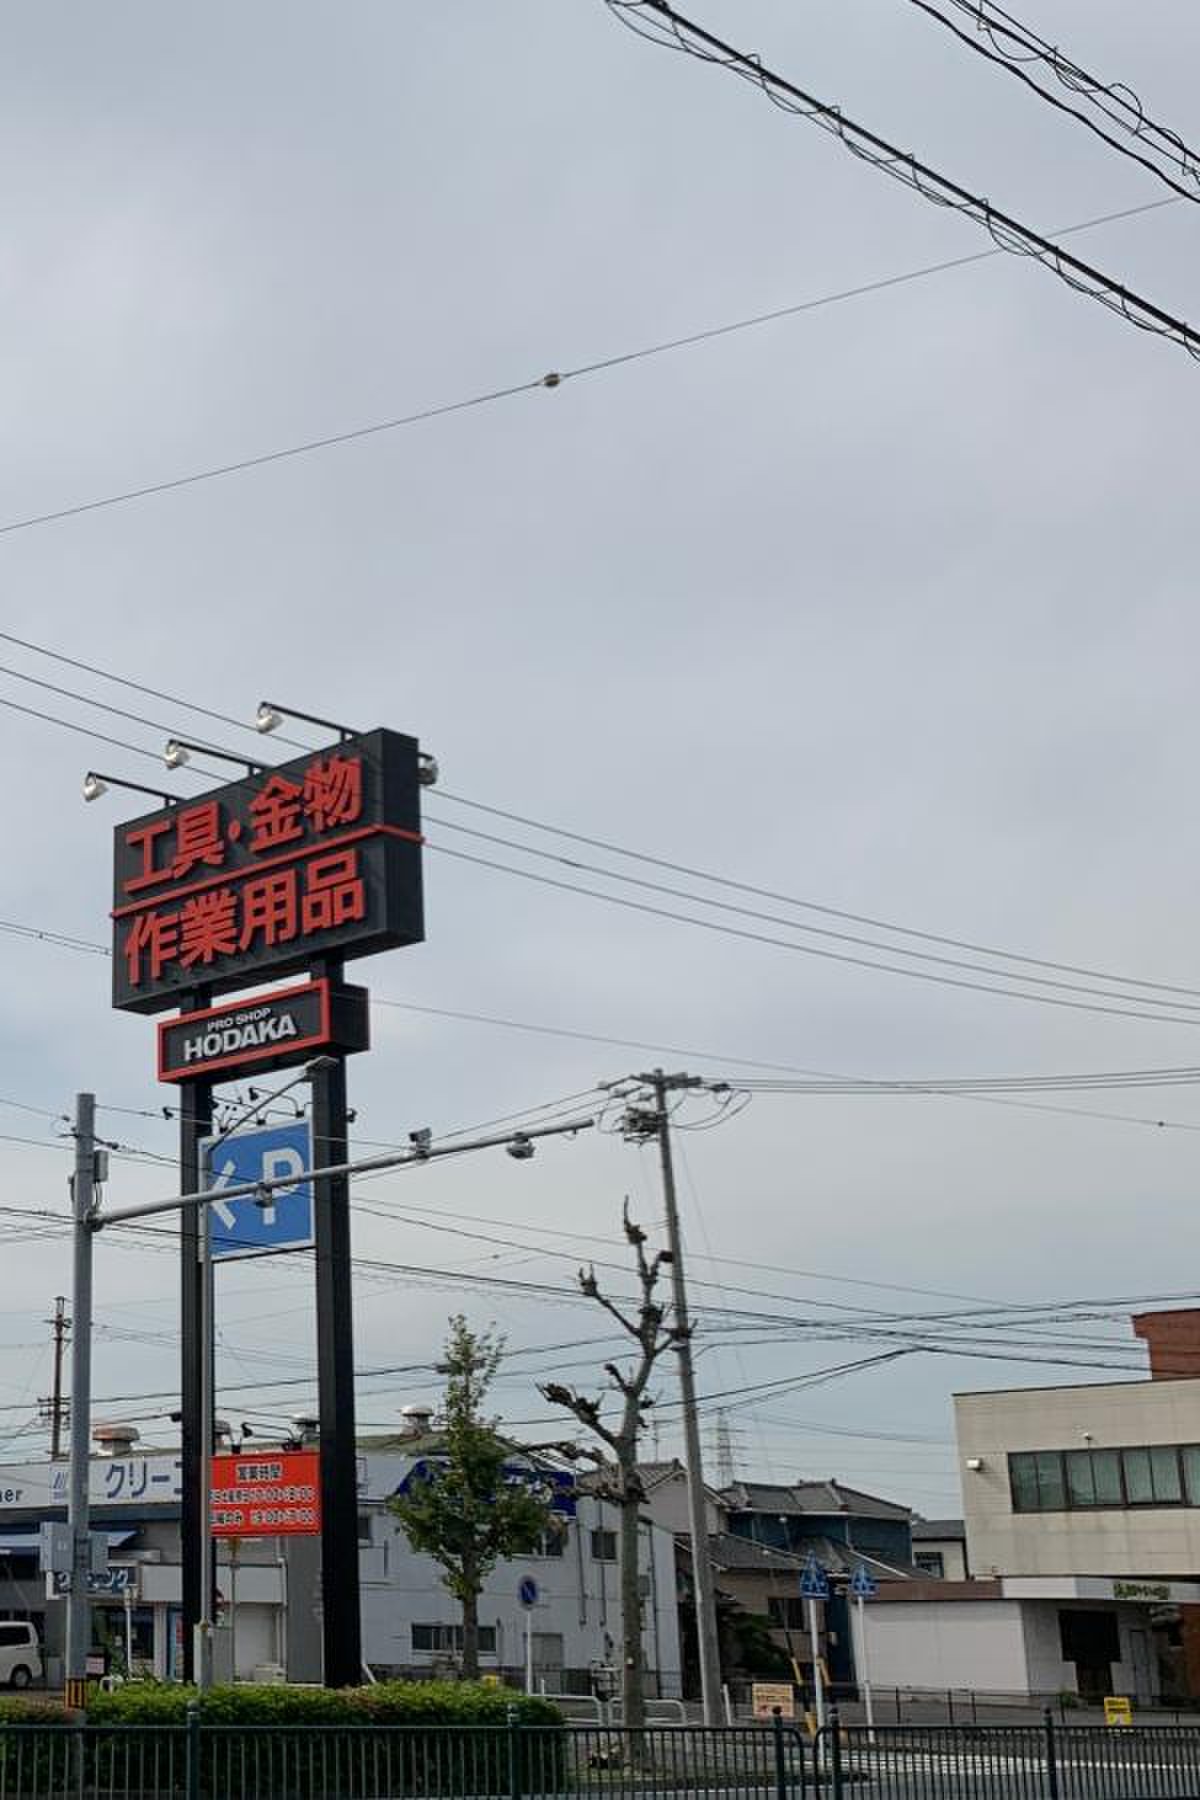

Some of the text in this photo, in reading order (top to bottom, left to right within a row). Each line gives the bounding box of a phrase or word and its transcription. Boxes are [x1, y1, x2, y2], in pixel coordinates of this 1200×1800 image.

[123, 755, 362, 893] 工具・金物
[125, 848, 365, 985] 作業用品
[184, 1014, 298, 1062] HODAKA
[207, 1007, 272, 1033] PRO SHOP
[262, 1147, 305, 1226] P
[105, 1460, 183, 1499] クリー
